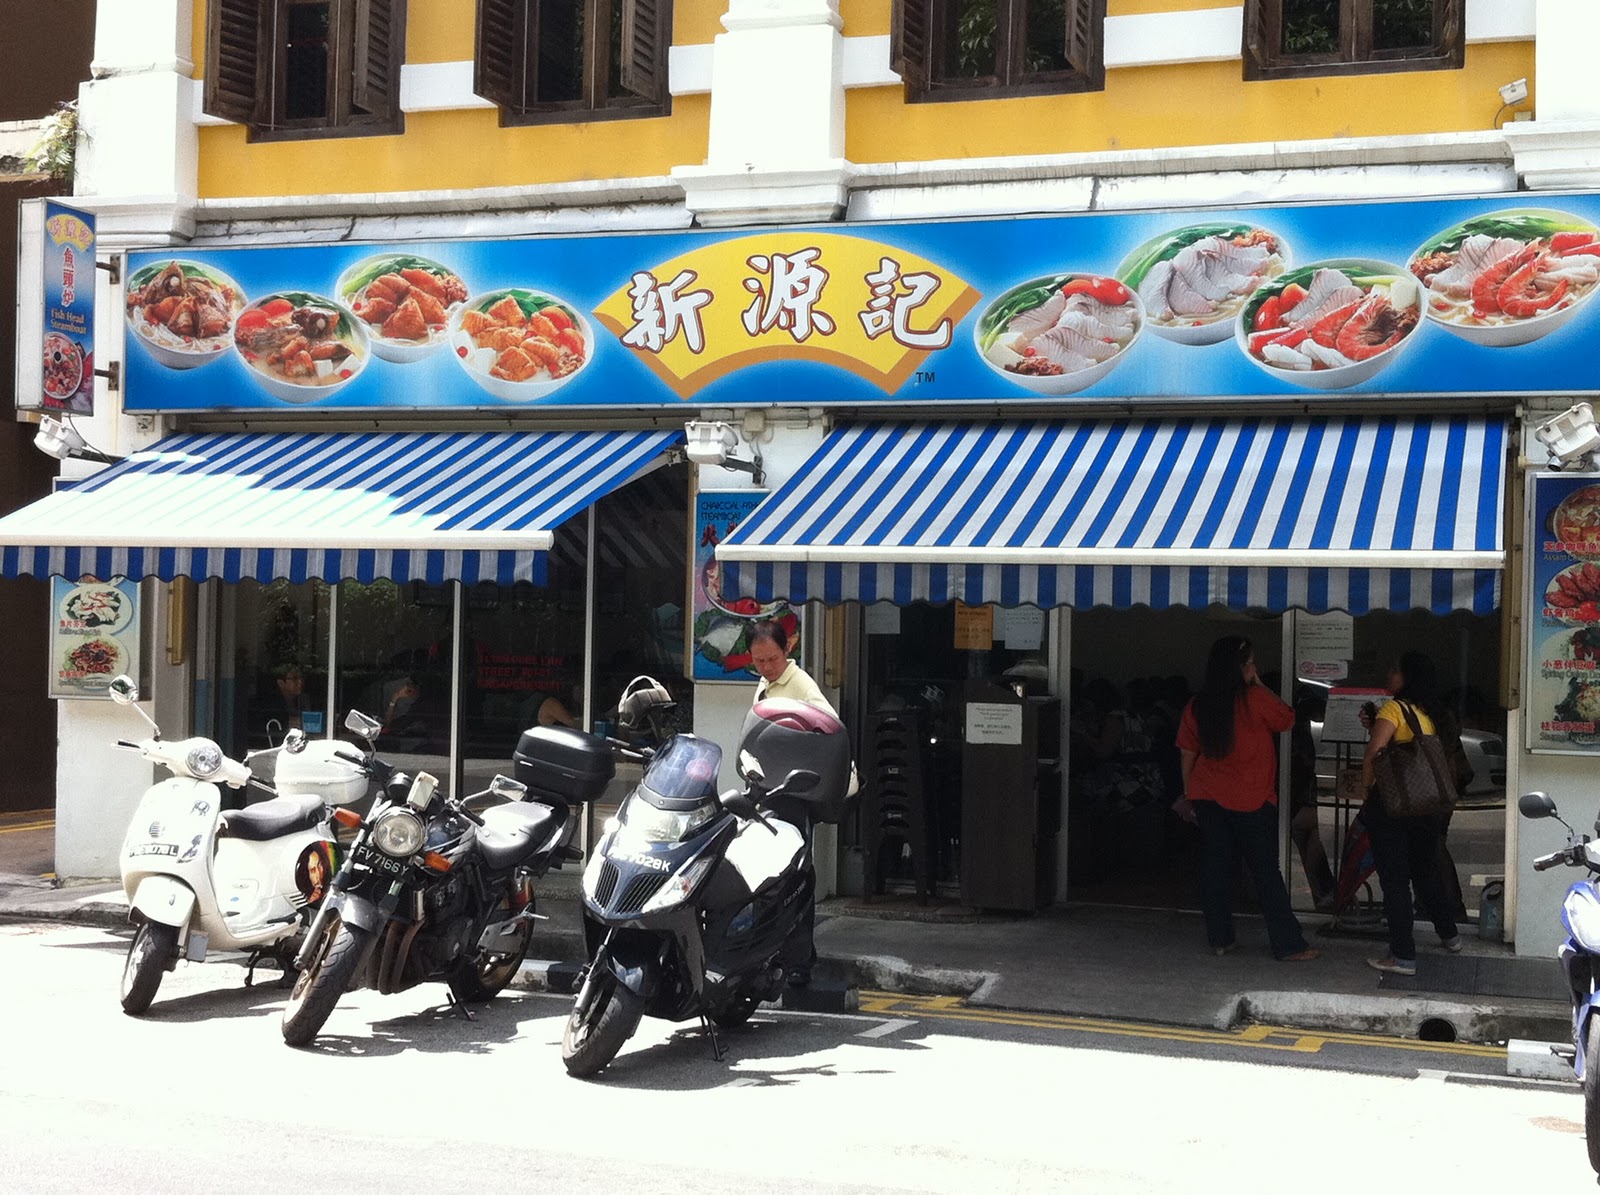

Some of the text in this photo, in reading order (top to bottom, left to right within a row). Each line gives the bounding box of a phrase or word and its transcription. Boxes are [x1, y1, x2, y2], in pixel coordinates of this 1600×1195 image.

[619, 246, 953, 354] 新源記
[51, 308, 84, 324] Fish Head
[916, 372, 936, 383] TM
